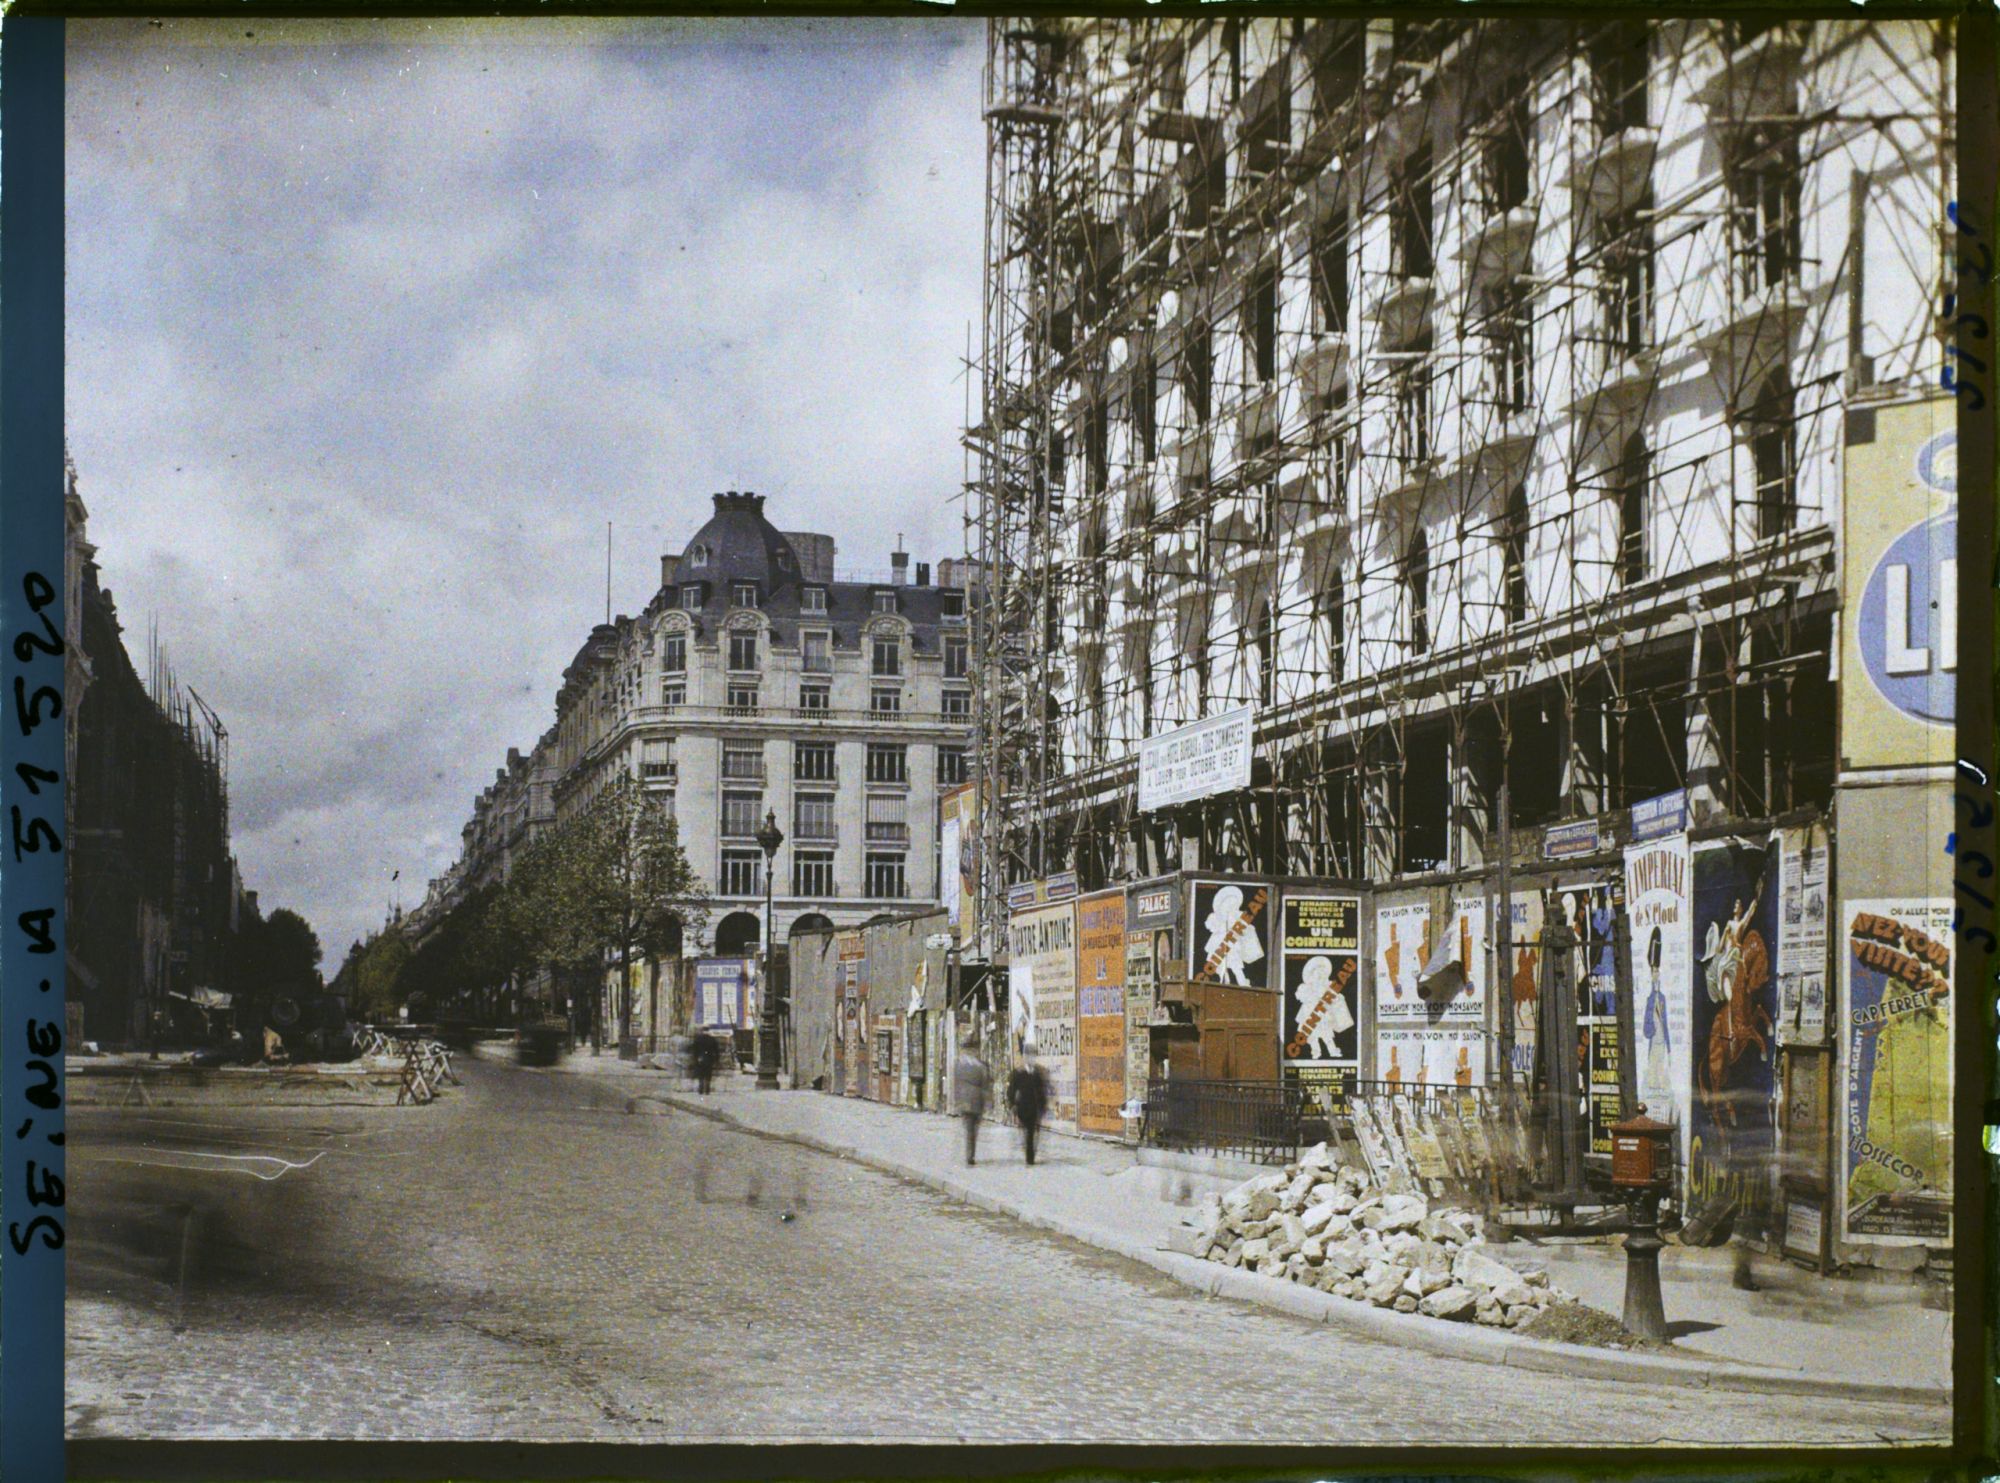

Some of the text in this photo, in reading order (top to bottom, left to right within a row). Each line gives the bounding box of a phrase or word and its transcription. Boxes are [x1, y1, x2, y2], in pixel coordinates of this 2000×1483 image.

[11, 571, 65, 864] 51520
[1190, 755, 1217, 777] OCTOBRE
[1139, 895, 1170, 914] PALACE
[1463, 900, 1483, 910] SAVON
[1380, 908, 1408, 919] MON SAVON
[1413, 907, 1423, 915] MON
[1653, 900, 1678, 925] Cloud
[1931, 907, 1950, 915] VOUS
[1299, 918, 1344, 928] EXIGEZ
[1039, 917, 1071, 953] ANTOINE
[1311, 927, 1333, 937] UN
[1286, 936, 1357, 948] COINTREAU
[1286, 958, 1357, 1058] COINTREAU
[1851, 991, 1928, 1024] CAP FERRET
[1392, 1032, 1408, 1040] SAVON
[1463, 1032, 1481, 1041] SAVON
[1850, 1029, 1864, 1091] D'ARGENT
